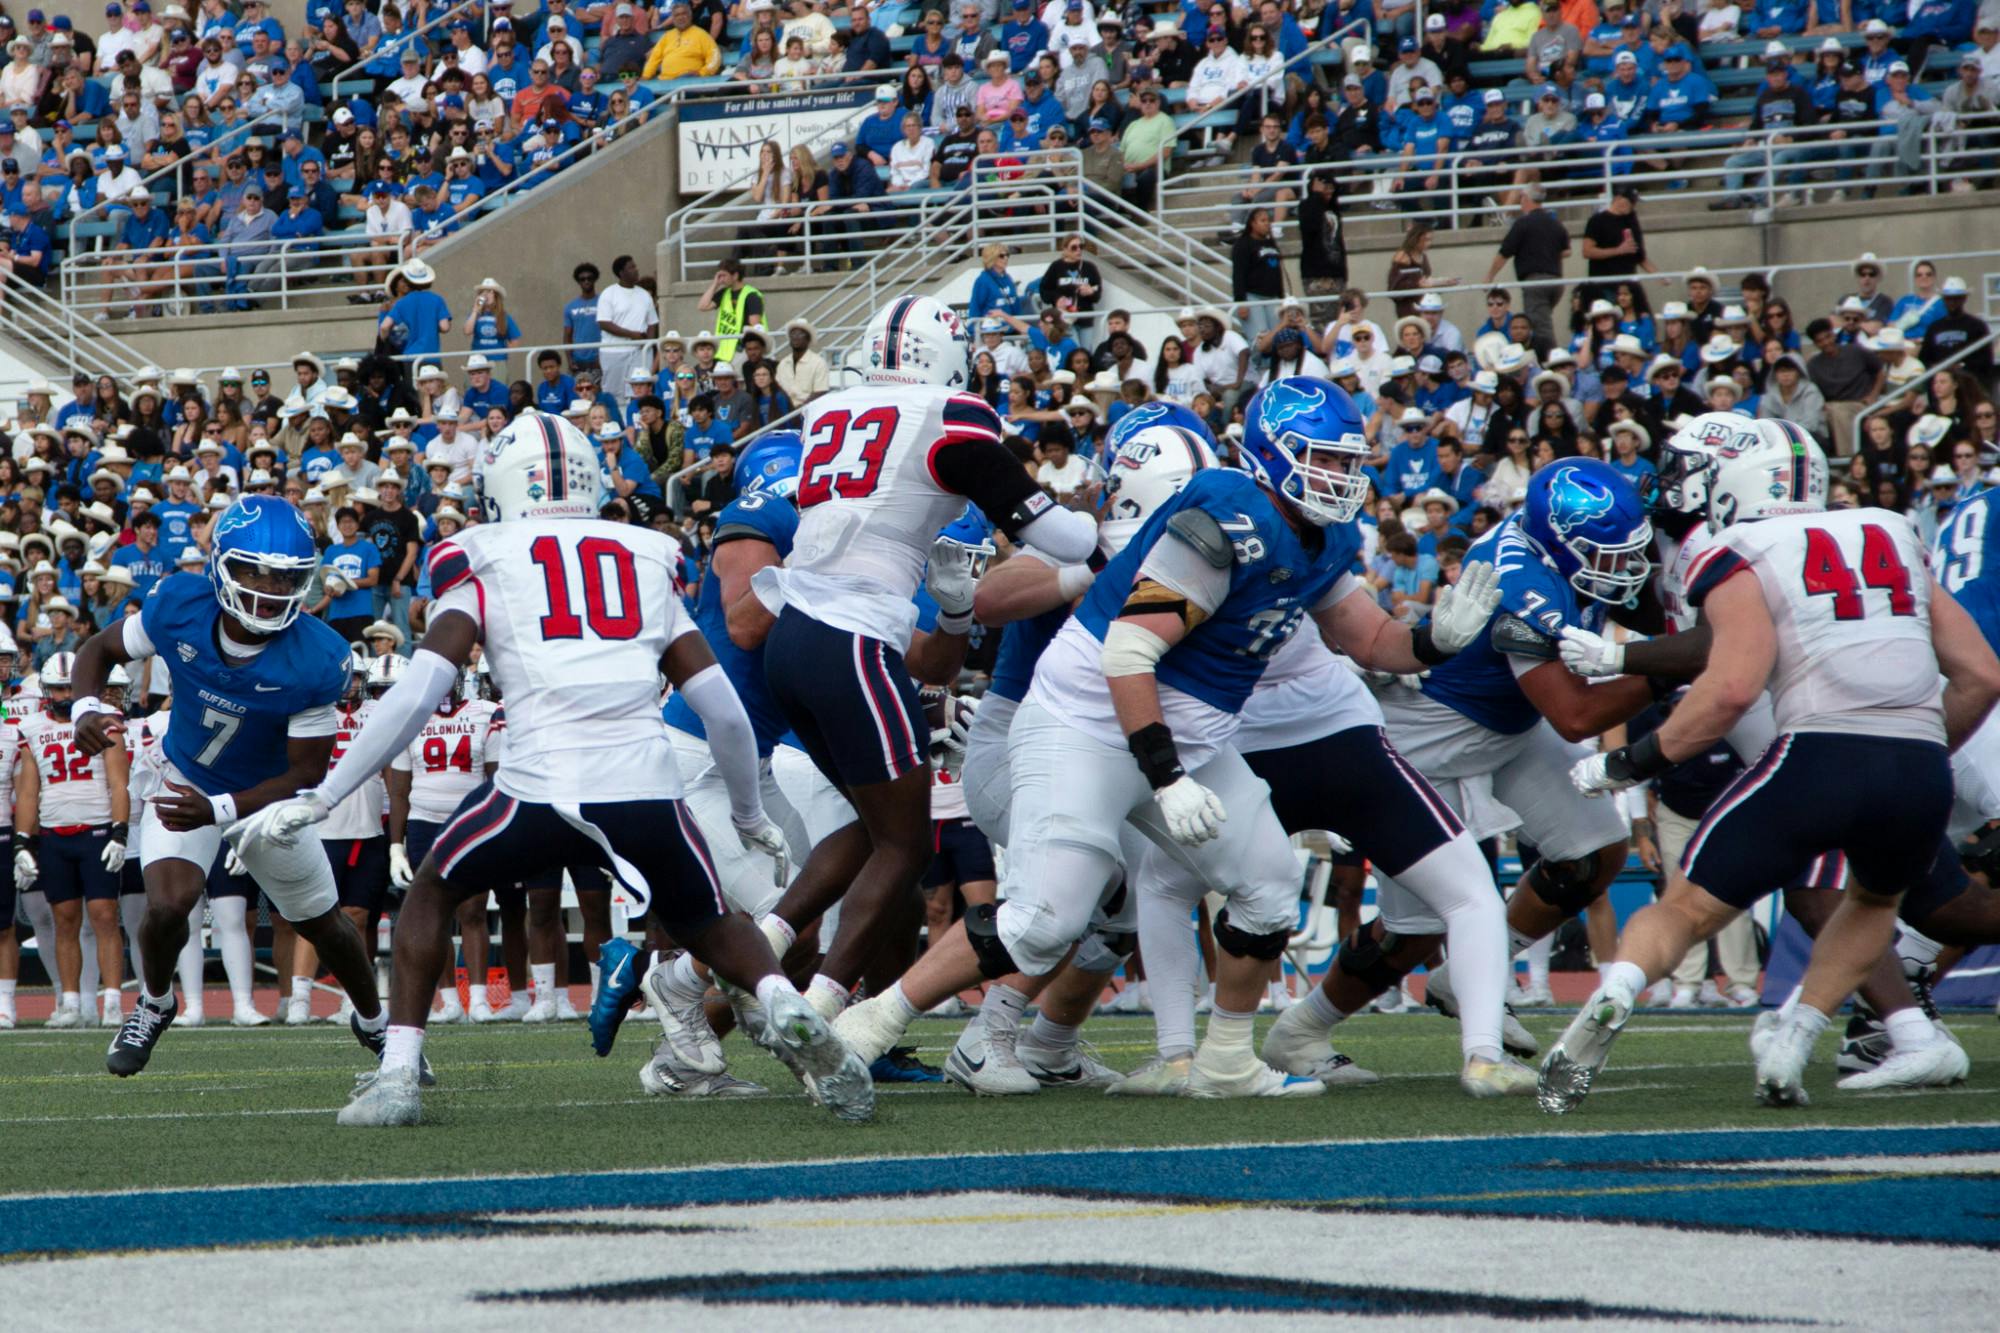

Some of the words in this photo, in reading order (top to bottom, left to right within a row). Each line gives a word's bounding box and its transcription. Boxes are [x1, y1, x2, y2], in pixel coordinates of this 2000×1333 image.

[724, 101, 741, 113] For
[742, 100, 755, 111] all
[756, 99, 770, 110] the
[772, 96, 800, 108] smiles
[801, 95, 812, 106] of
[813, 94, 835, 108] your
[836, 91, 855, 102] life!
[691, 123, 778, 161] WNY
[870, 374, 918, 385] COLONIALS
[797, 405, 901, 510] 23
[530, 505, 585, 517] COLONIALS
[1218, 512, 1266, 566] 78
[529, 534, 644, 642] 10
[1802, 523, 1918, 622] 44
[198, 688, 248, 715] BUFFALO
[39, 730, 73, 745] COLONI
[192, 703, 246, 769] 7
[419, 723, 476, 738] COLONIALS
[43, 742, 94, 785] 32
[422, 734, 473, 774] 94
